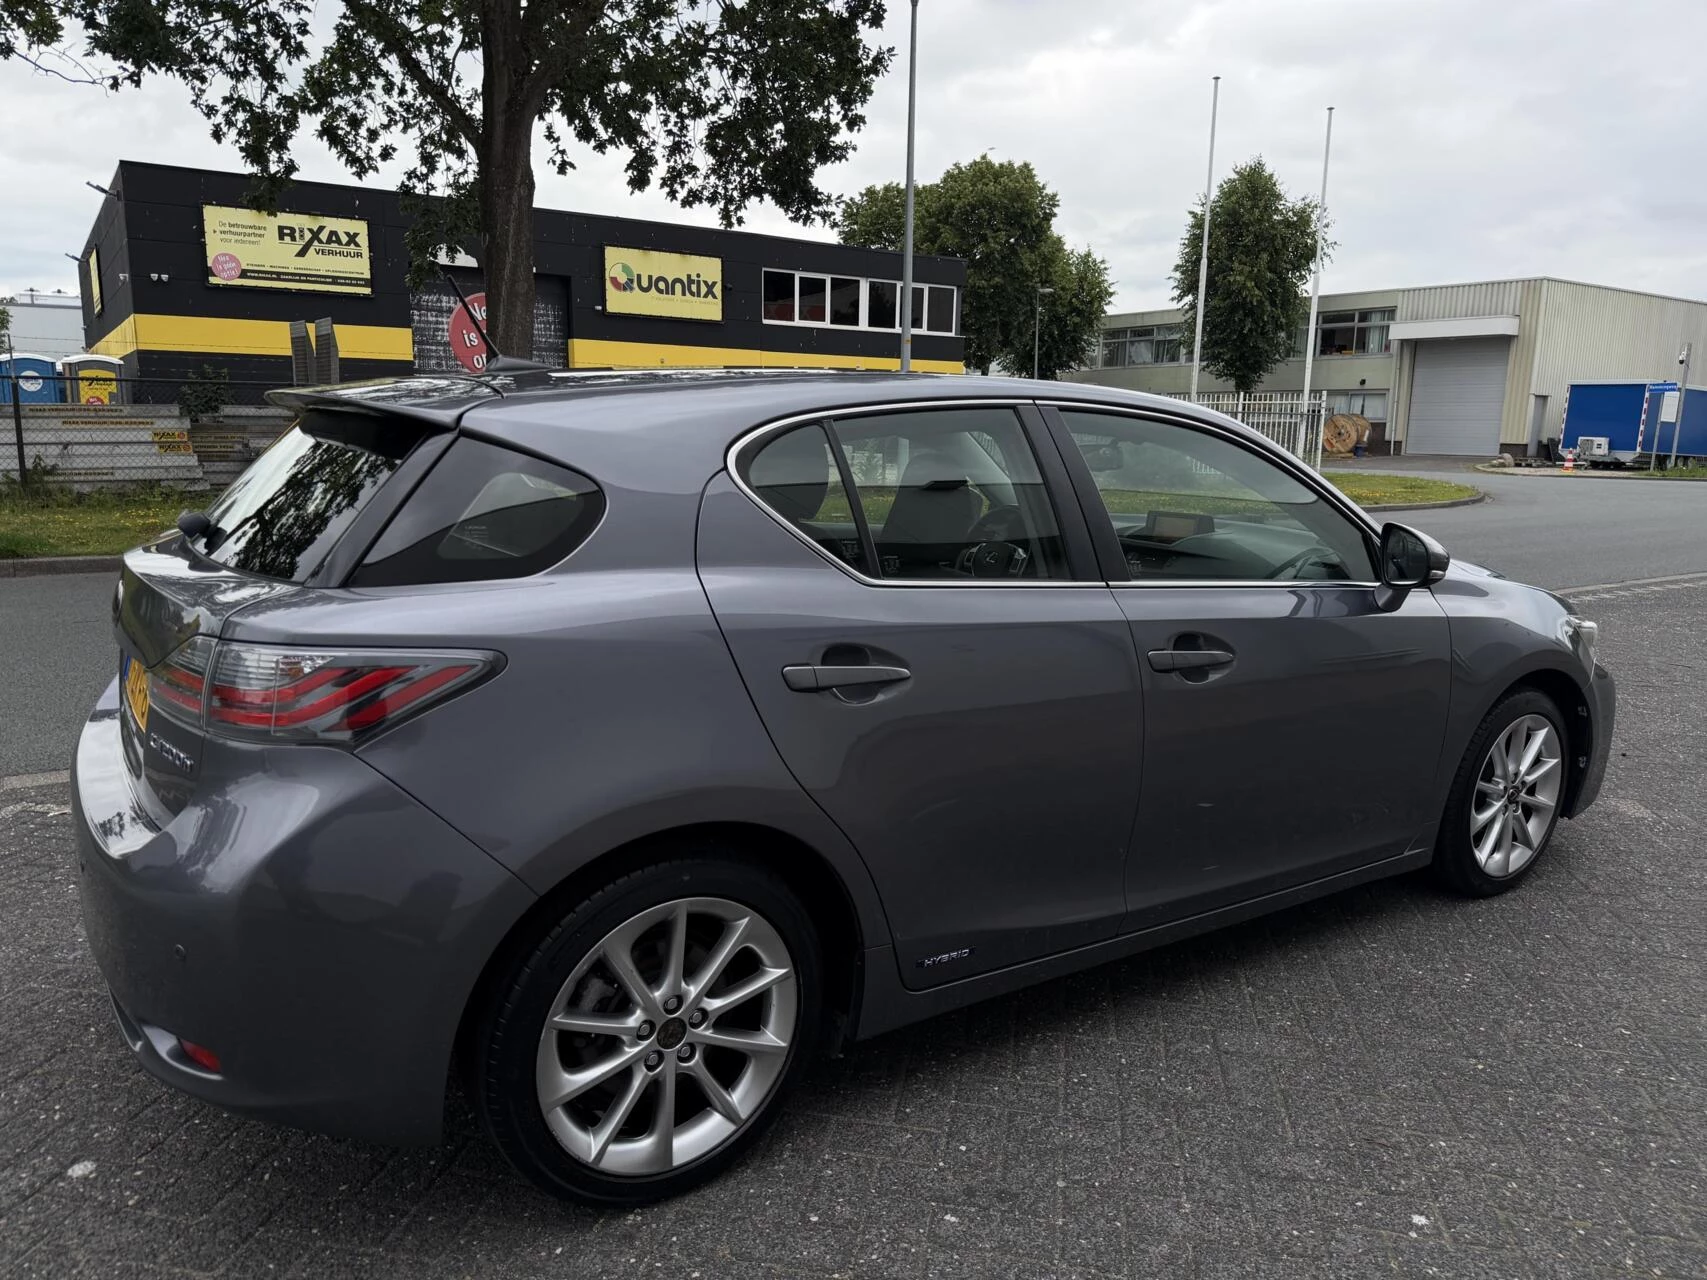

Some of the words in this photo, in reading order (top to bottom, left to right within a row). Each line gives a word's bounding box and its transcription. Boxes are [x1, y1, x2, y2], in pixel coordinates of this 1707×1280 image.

[219, 229, 265, 239] verhuurpartner
[228, 222, 267, 231] betrouwbare
[314, 247, 363, 259] VERHUUR
[609, 261, 719, 300] Quantix
[462, 329, 479, 348] is
[924, 948, 970, 967] HYBRID
